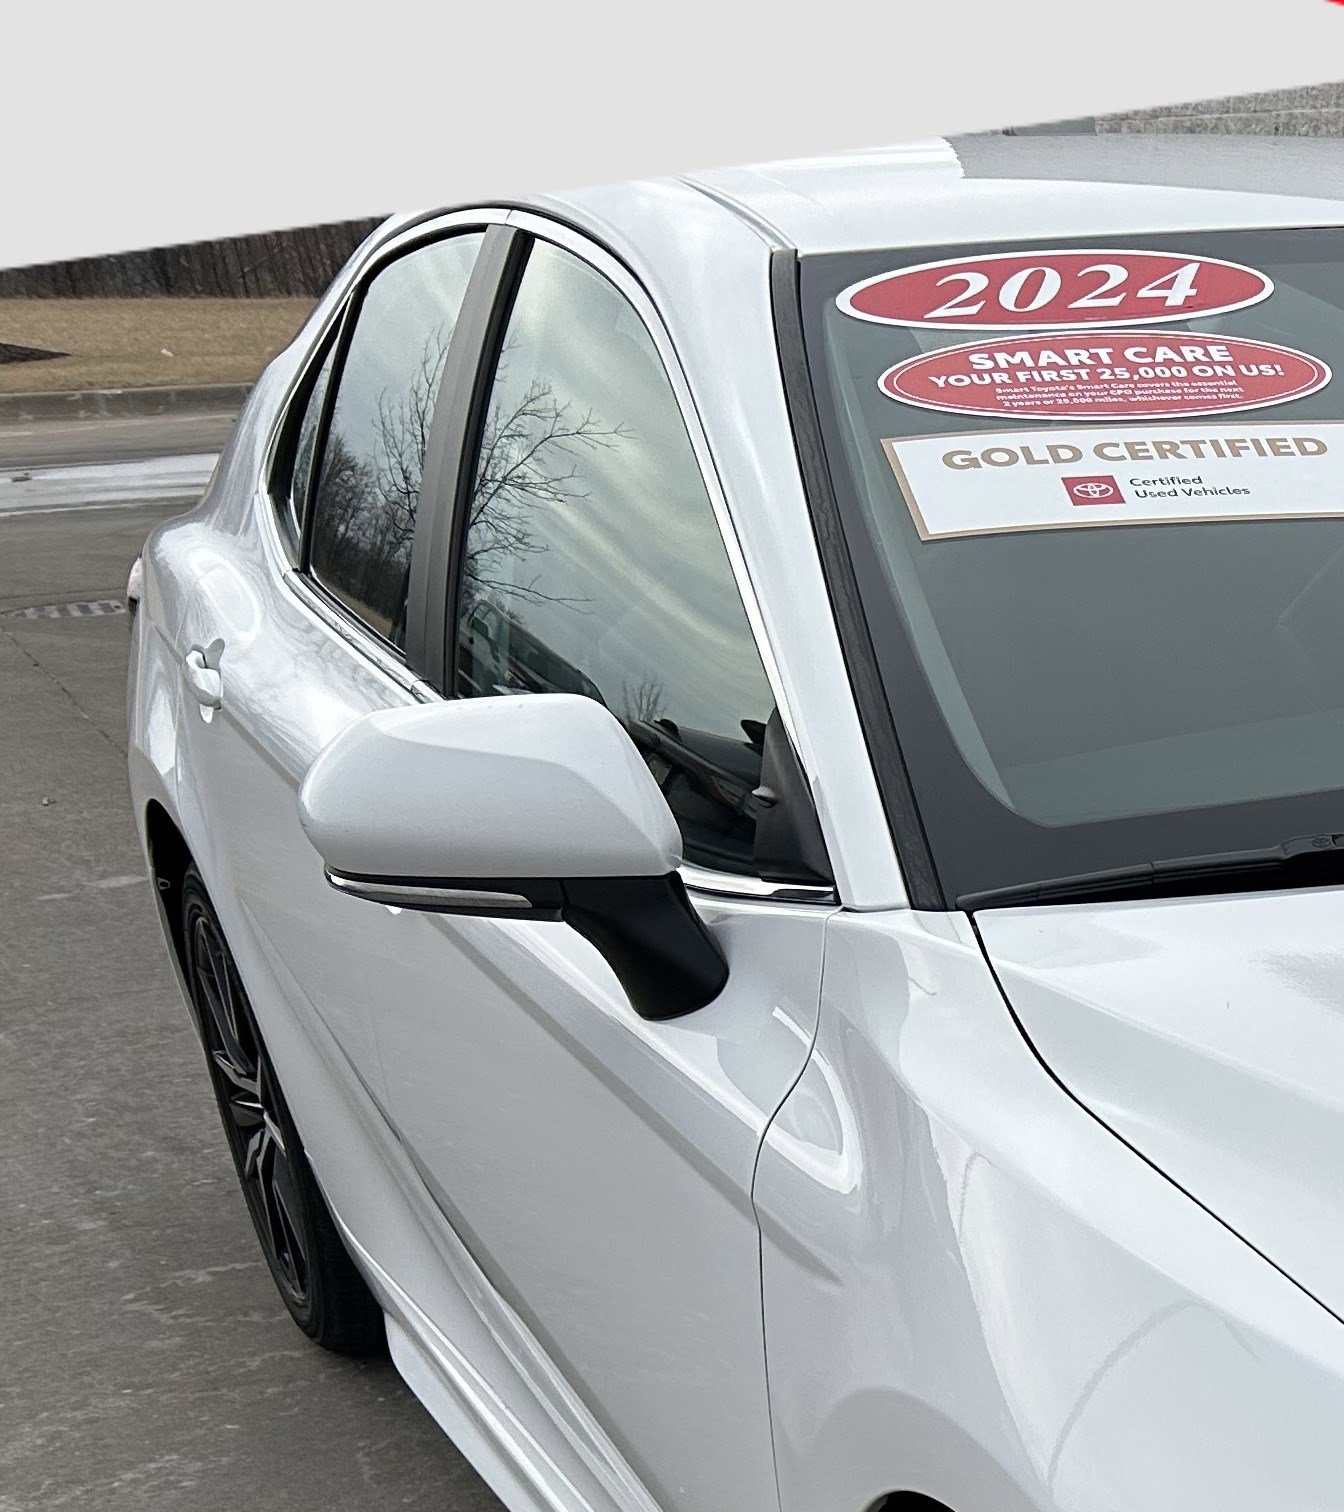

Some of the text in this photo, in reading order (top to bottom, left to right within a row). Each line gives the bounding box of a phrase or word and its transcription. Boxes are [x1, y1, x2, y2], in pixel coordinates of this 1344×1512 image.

[923, 261, 1200, 319] 2024
[969, 345, 1234, 370] SMART CARE
[928, 363, 1285, 388] YOUR FIRST 25,000 ON US!
[941, 437, 1329, 471] GOLD CERTIFIED
[1129, 475, 1203, 488] Certified
[1134, 484, 1251, 499] Used Vehicles
